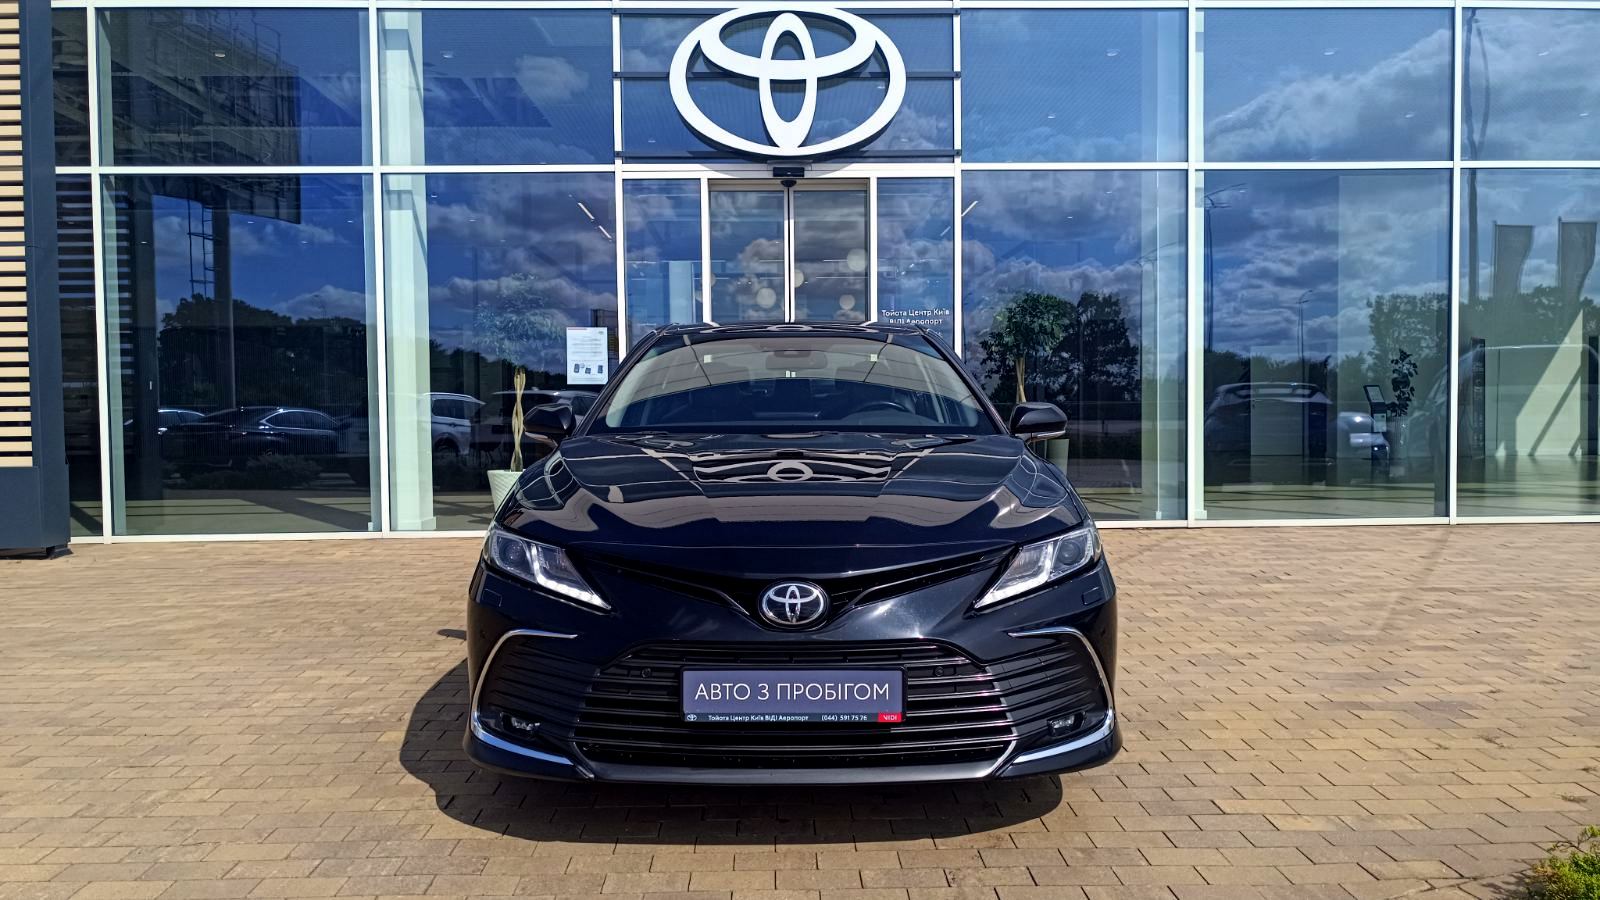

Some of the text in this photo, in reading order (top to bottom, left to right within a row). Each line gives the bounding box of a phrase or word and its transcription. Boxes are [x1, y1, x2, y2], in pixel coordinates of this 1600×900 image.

[908, 309, 931, 317] Центр
[694, 683, 751, 700] АВТО
[777, 683, 889, 700] ПРОБІГОМ
